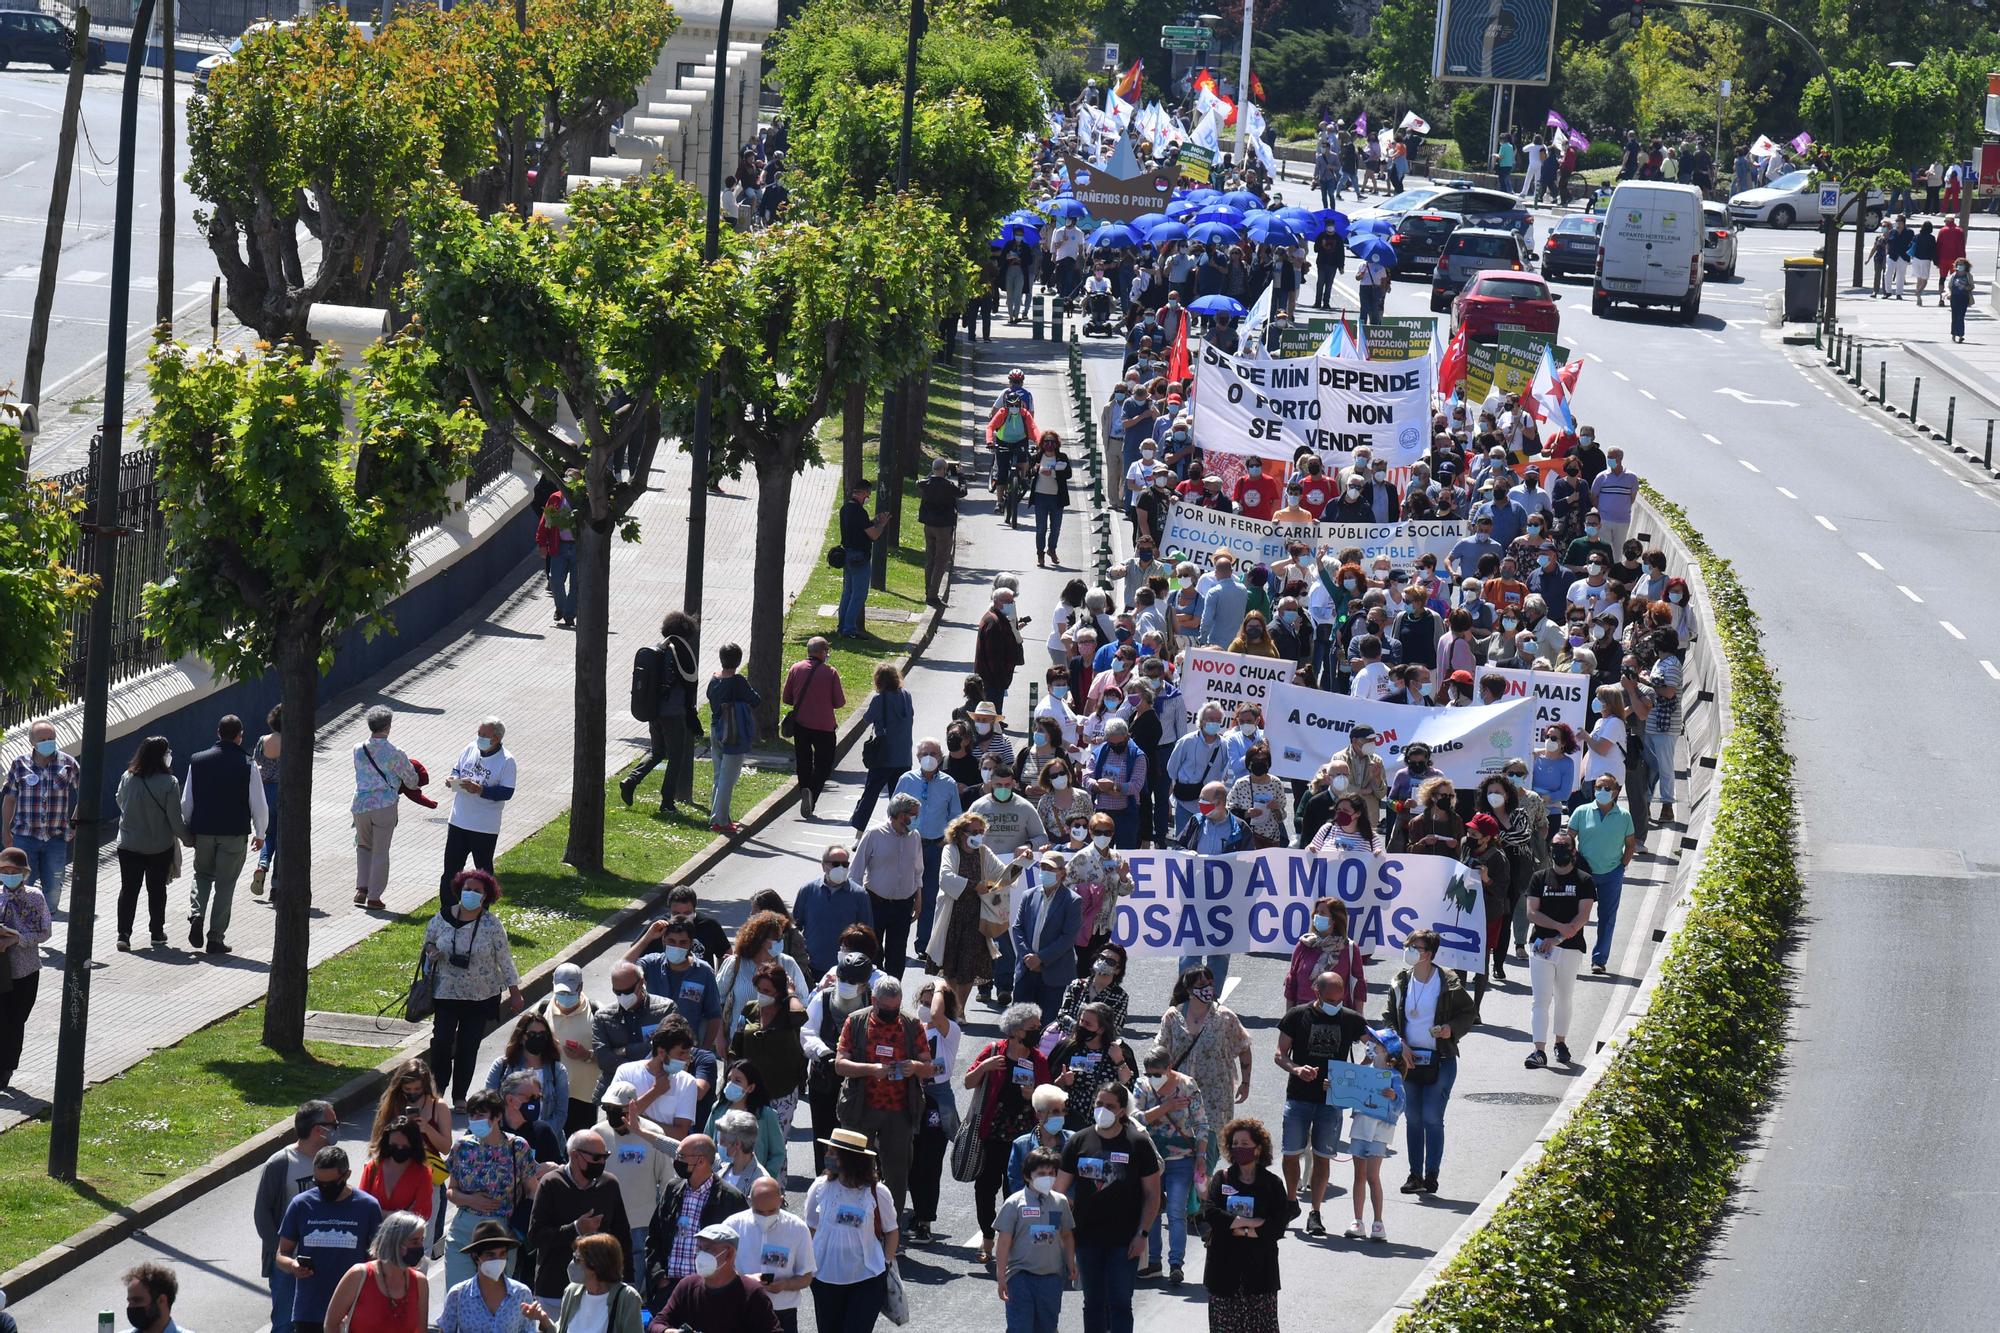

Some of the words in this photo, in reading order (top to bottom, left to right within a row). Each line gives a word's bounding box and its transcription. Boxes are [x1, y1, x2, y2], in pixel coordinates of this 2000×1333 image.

[1076, 190, 1120, 205] GAÑEMOS
[1122, 195, 1129, 206] O
[1132, 195, 1163, 208] PORTO
[1366, 339, 1408, 348] VATIZACIÓN
[1370, 329, 1393, 338] NON
[1372, 348, 1404, 357] PORTO
[1473, 347, 1491, 361] NON
[1528, 341, 1544, 353] NO
[1203, 345, 1233, 371] SE
[1236, 364, 1266, 387] DE
[1319, 367, 1420, 393] DEPENDE
[1511, 356, 1525, 366] DO
[1470, 366, 1492, 380] PORTO
[1227, 383, 1243, 404] O
[1256, 393, 1321, 421] PORTO
[1347, 403, 1393, 425] NON
[1248, 417, 1283, 441] SE
[1305, 428, 1373, 453] VENDE
[1175, 505, 1204, 523] POR
[1208, 512, 1226, 527] UN
[1230, 518, 1323, 539] FERROCARRIL
[1328, 524, 1391, 540] PÚBLICO
[1395, 526, 1403, 538] E
[1407, 525, 1463, 538] SOCIAL
[1170, 526, 1253, 552] ECOLÓXICO
[1192, 659, 1235, 676] NOVO
[1239, 665, 1286, 683] CHUAC
[1207, 678, 1242, 695] PARA
[1246, 684, 1267, 698] OS
[1502, 680, 1527, 697] ON
[1534, 683, 1582, 702] MAIS
[1288, 709, 1301, 724] A
[1305, 713, 1355, 733] Coruñ
[1374, 728, 1398, 747] ON
[1111, 904, 1235, 948] OSAS
[1248, 901, 1419, 950] COTAS
